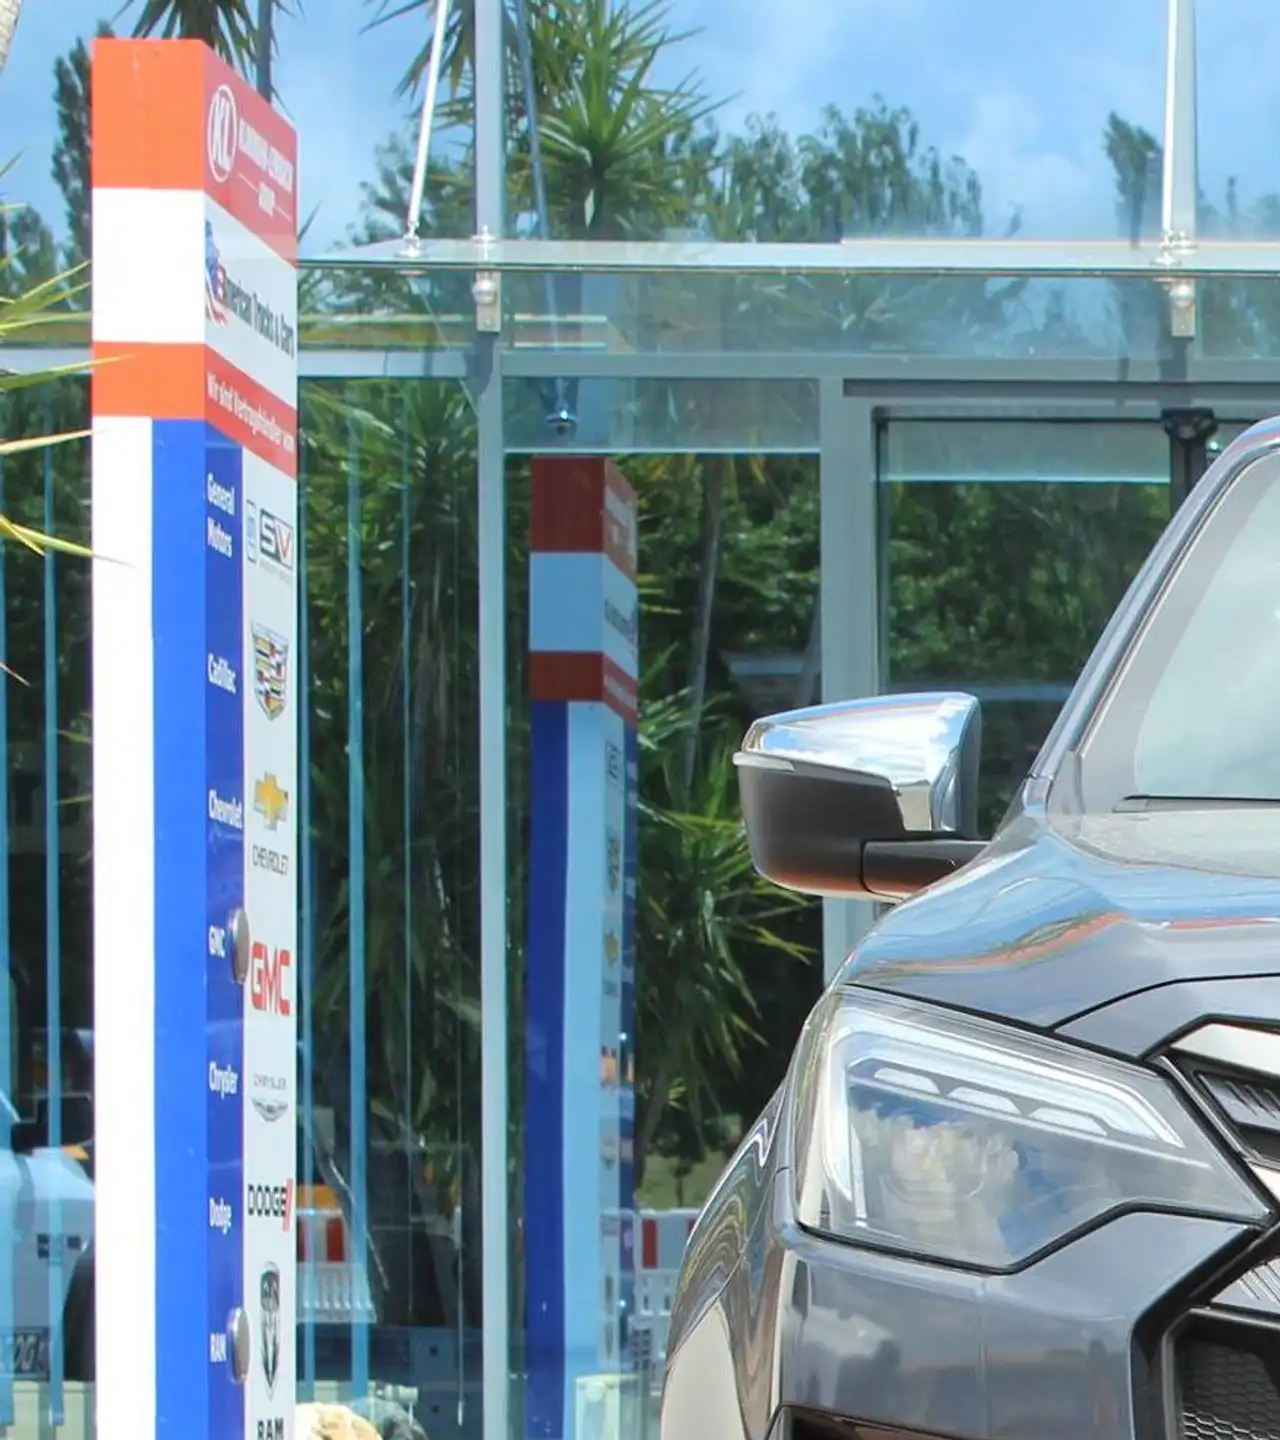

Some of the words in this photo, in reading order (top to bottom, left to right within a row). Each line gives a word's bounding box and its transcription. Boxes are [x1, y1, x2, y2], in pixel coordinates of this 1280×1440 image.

[207, 472, 235, 516] General
[207, 516, 233, 558] Motors
[208, 653, 236, 694] Cadillac
[208, 789, 243, 830] Chevrolet
[251, 941, 291, 1017] GMC
[208, 1061, 239, 1100] Chrysler
[208, 1196, 232, 1235] Dodge
[247, 1184, 287, 1218] DODGE
[209, 1332, 227, 1363] RAM
